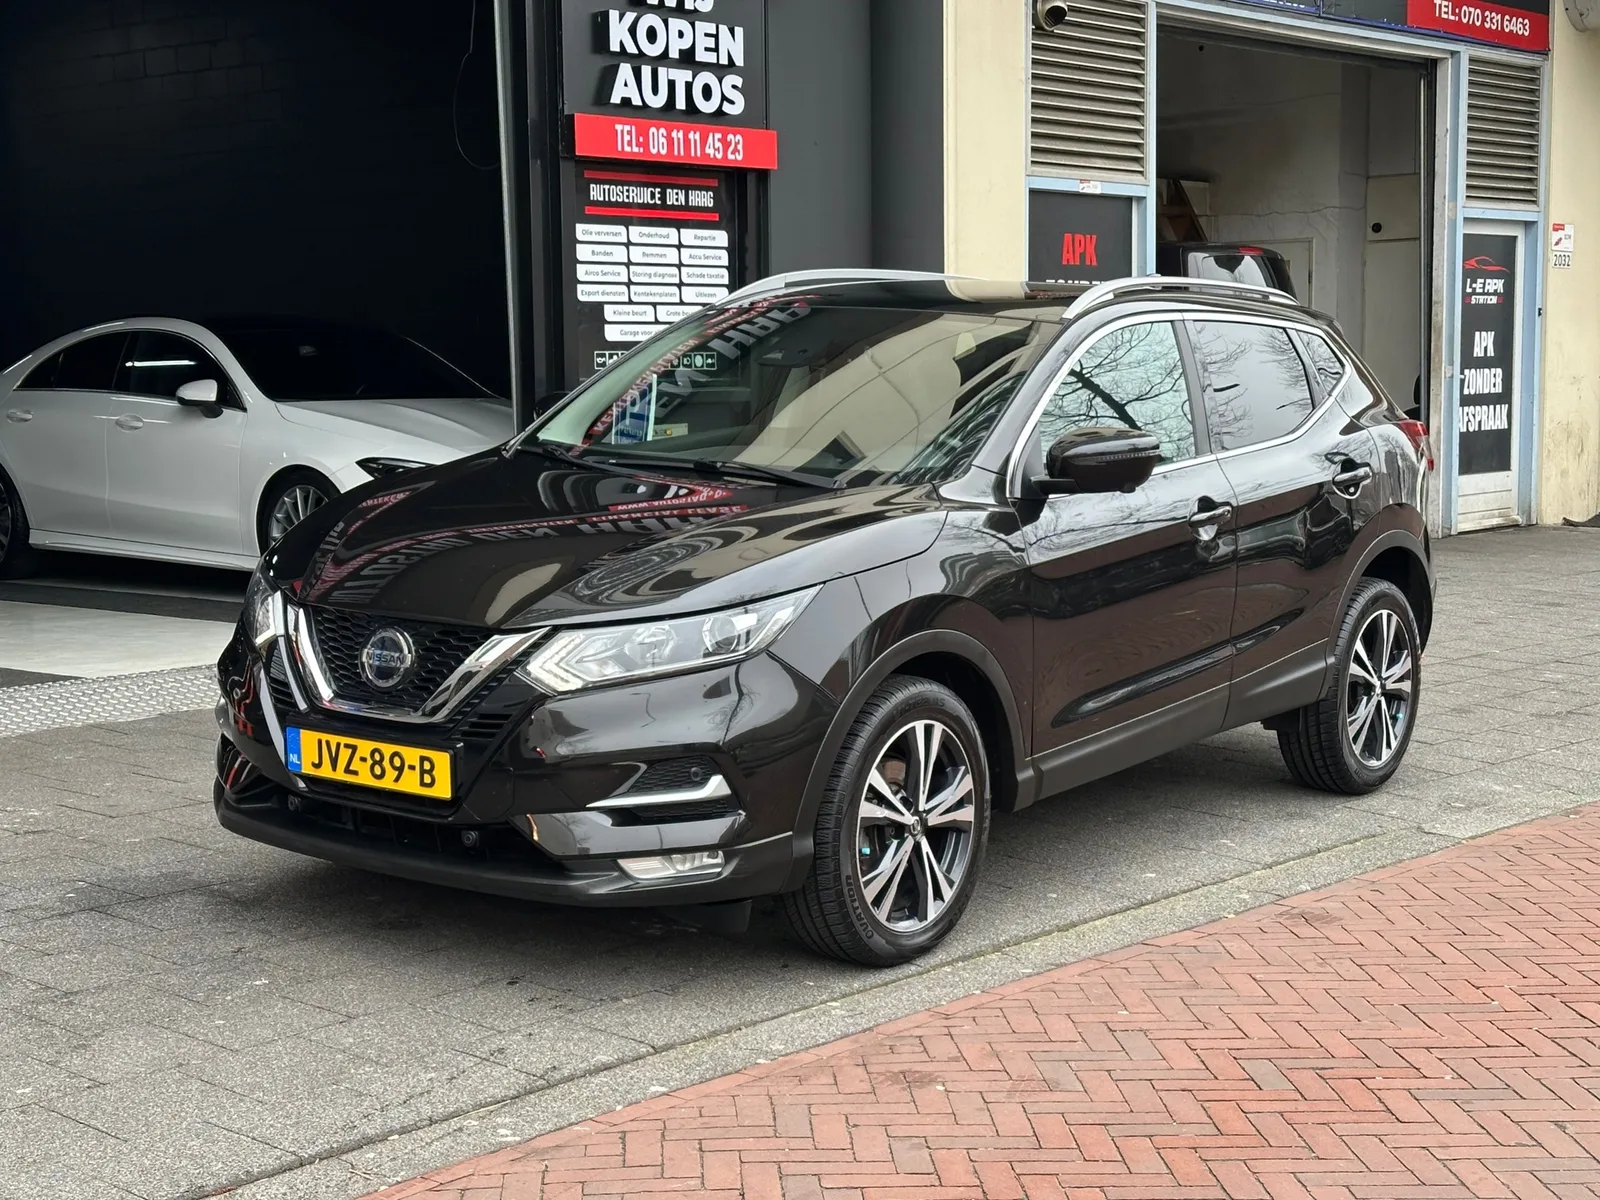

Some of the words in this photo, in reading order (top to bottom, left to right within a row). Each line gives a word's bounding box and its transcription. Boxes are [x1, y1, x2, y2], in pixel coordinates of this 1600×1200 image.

[1434, 0, 1459, 21] TEL:
[1461, 6, 1482, 27] 070
[1484, 13, 1502, 31] 331
[1503, 16, 1530, 37] 6463
[609, 9, 744, 67] KOPEN
[610, 63, 745, 115] AUTOS
[615, 124, 643, 153] TEL:
[648, 127, 667, 156] 06
[671, 129, 685, 157] 11
[688, 131, 700, 158] 11
[705, 132, 723, 160] 45
[727, 134, 743, 161] 23
[589, 183, 662, 204] AUTOSERVICE
[666, 188, 685, 207] DEN
[688, 190, 714, 208] HAAG
[581, 229, 593, 237] Olie
[638, 231, 670, 240] Onderhoud
[591, 249, 614, 258] Banden
[1062, 233, 1098, 266] APK
[642, 251, 667, 260] Remmen
[688, 253, 702, 261] Accu
[703, 254, 722, 262] Service
[1553, 254, 1571, 267] 2032
[584, 269, 599, 278] Airco
[600, 270, 621, 278] Service
[631, 270, 651, 280] Storing
[652, 270, 677, 280] diagnose
[686, 272, 706, 280] Schade
[706, 272, 725, 280] taxatie
[1466, 278, 1484, 293] L-E
[1485, 279, 1504, 293] APK
[581, 289, 599, 299] Export
[601, 289, 625, 297] diensten
[633, 290, 677, 299] Kentekenplaten
[695, 291, 717, 299] Uitlezen
[1471, 295, 1497, 305] STATION
[613, 308, 630, 317] Kleine
[631, 309, 647, 317] beurt
[666, 310, 680, 318] Grote
[620, 329, 640, 338] Garage
[1473, 331, 1495, 358] APK
[1463, 368, 1502, 395] ZONDER
[289, 752, 301, 765] NL
[311, 738, 436, 788] JVZ-89-B
